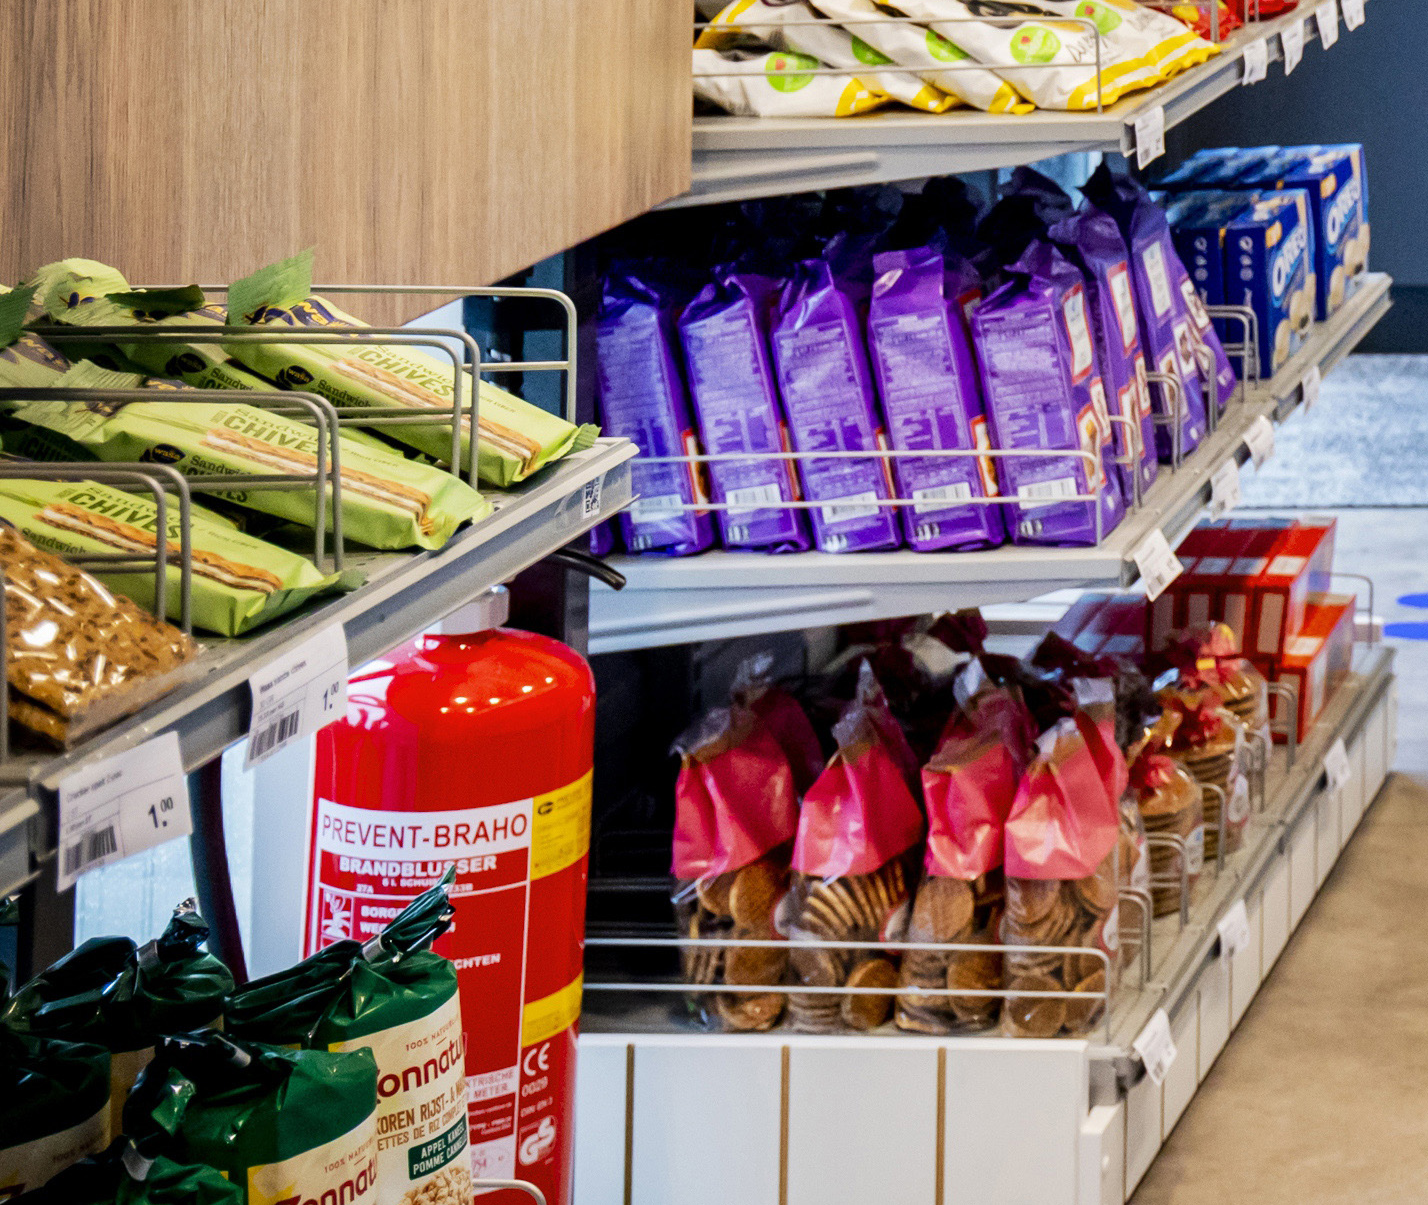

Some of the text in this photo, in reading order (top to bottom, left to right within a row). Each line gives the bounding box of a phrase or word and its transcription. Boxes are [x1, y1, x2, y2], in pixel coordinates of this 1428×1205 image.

[359, 348, 456, 398] CHIVES
[154, 446, 183, 461] wasa
[148, 795, 174, 830] 1.00
[321, 812, 529, 850] PREVENT-BRAHO
[339, 854, 498, 879] BRANDBLUSSER
[377, 1032, 466, 1104] onnatu
[522, 1042, 551, 1077] CE
[413, 1153, 445, 1176] POMME
[421, 1138, 446, 1160] APPEL
